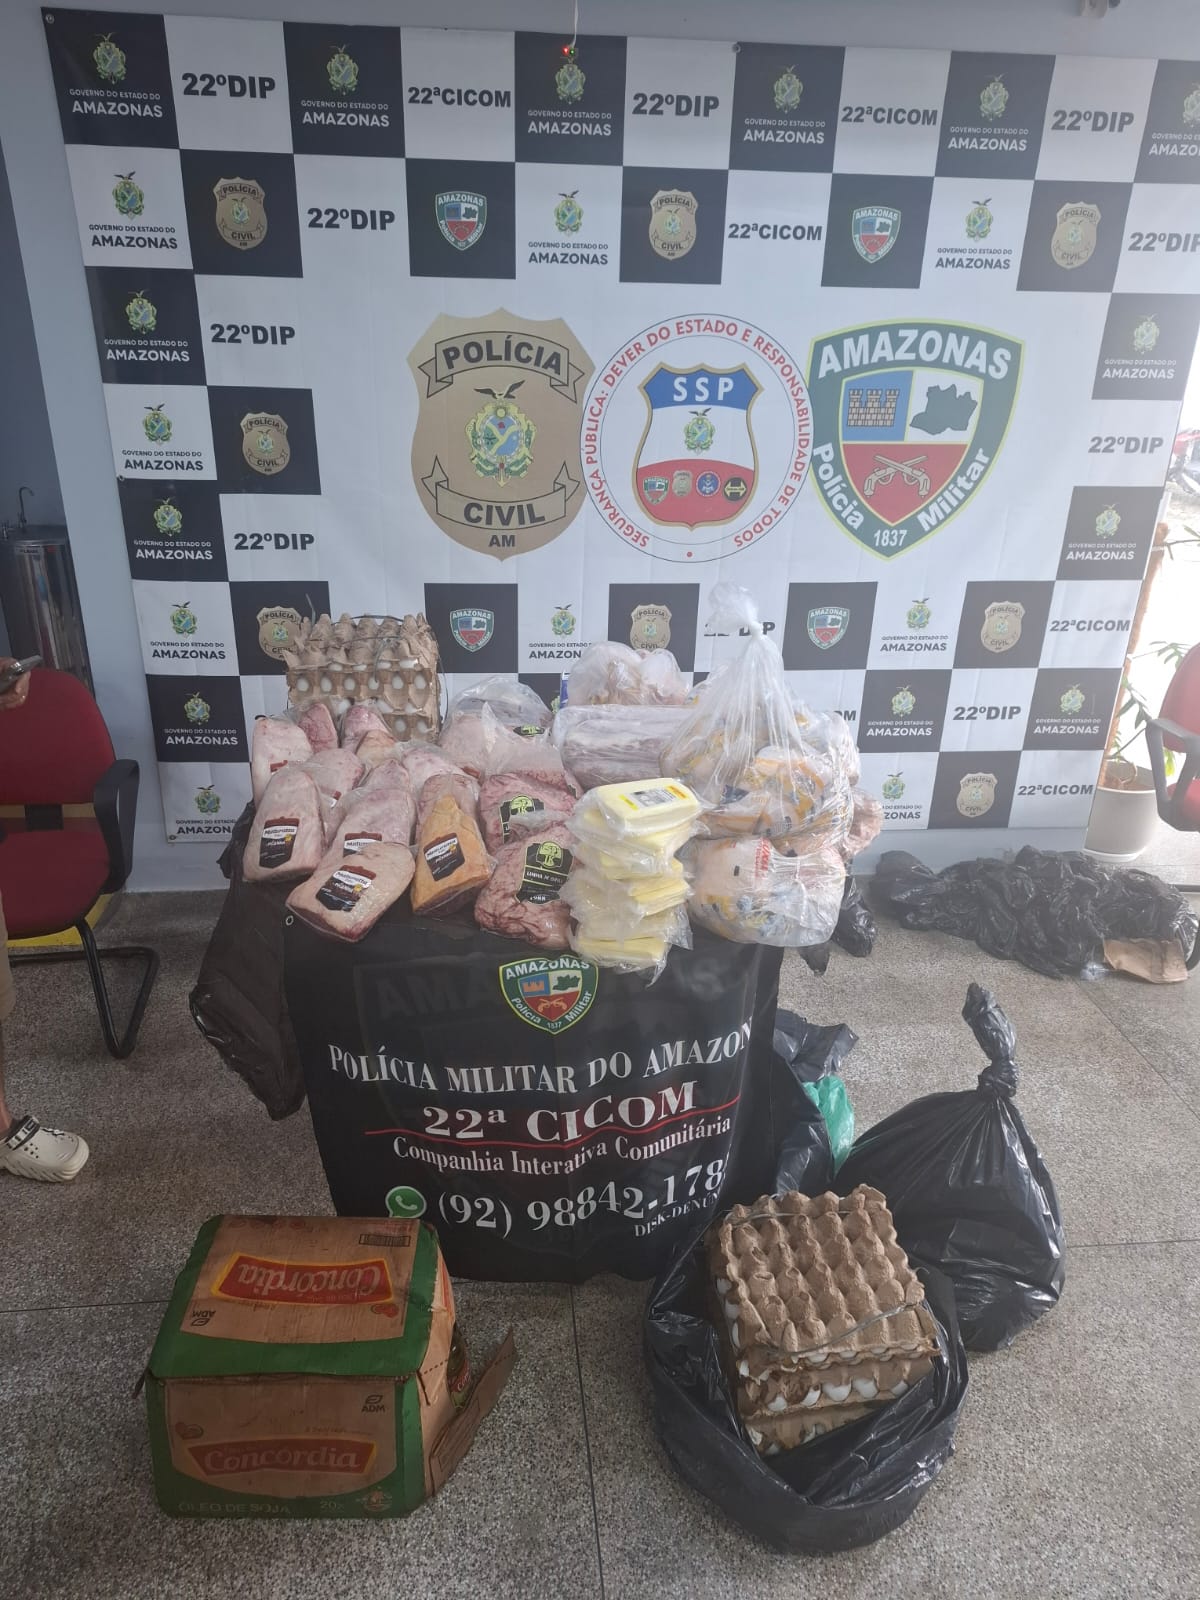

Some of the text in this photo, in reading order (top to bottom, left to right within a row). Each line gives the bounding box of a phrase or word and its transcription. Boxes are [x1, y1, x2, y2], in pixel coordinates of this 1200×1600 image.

[69, 88, 160, 100] GOVERNO DO ESTADO DO
[72, 100, 163, 118] AMAZONAS
[300, 100, 335, 108] GOVERNO
[336, 101, 348, 109] DO
[349, 101, 377, 110] ESTADO
[302, 111, 390, 128] AMAZONAS
[527, 109, 560, 118] GOVERNO
[574, 111, 600, 119] ESTADO
[527, 121, 612, 136] AMAZONAS
[744, 118, 776, 126] GOVERNO
[743, 129, 825, 144] AMAZONAS
[950, 126, 981, 134] GOVERNO
[993, 127, 1018, 135] ESTADO
[948, 137, 1027, 151] AMAZONAS
[1149, 143, 1200, 156] AMAZO
[222, 184, 257, 195] POLÍCIA
[438, 195, 484, 207] AMAZONAS
[659, 195, 691, 207] POLÍCIA
[854, 209, 898, 221] AMAZONAS
[89, 224, 123, 232] GOVERNO
[137, 225, 164, 233] ESTADO
[91, 234, 178, 250] AMAZONAS
[231, 231, 255, 241] CIVIL
[661, 242, 683, 250] CIVIL
[937, 247, 967, 255] GOVERNO
[528, 252, 608, 265] AMAZONAS
[1061, 252, 1082, 260] CIVIL
[935, 257, 1011, 270] AMAZONAS
[676, 318, 738, 336] ESTADO
[646, 326, 670, 346] DO
[741, 328, 752, 342] E
[106, 349, 190, 362] AMAZONAS
[442, 334, 561, 376] POLÍCIA
[818, 329, 1012, 380] AMAZONAS
[603, 342, 646, 387] DEVER
[1102, 368, 1176, 379] AMAZONAS
[753, 336, 810, 482] RESPONSABILIDADE
[249, 416, 280, 429] POLÍCIA
[124, 459, 204, 471] AMAZONAS
[256, 459, 278, 467] CIVIL
[813, 442, 864, 530] Polícia
[916, 447, 991, 532] Militar
[778, 488, 795, 506] DE
[463, 502, 546, 526] CIVIL
[592, 468, 650, 548] SEGURANÇA
[734, 506, 782, 547] TODOS
[134, 539, 164, 547] GOVERNO
[488, 534, 516, 547] AM
[873, 529, 907, 547] 1837
[135, 548, 214, 560] AMAZONAS
[1066, 551, 1135, 561] AMAZONAS
[880, 642, 947, 652] AMAZONAS
[152, 649, 226, 660] AMAZONAS
[528, 650, 582, 659] AMAZON
[866, 727, 932, 737] AMAZONAS
[1034, 725, 1100, 735] AMAZONAS
[166, 736, 239, 746] AMAZONAS
[884, 810, 921, 820] ZONAS
[177, 826, 232, 835] AMAZON
[505, 958, 590, 980] AMAZONAS
[511, 997, 541, 1024] Polícia
[565, 991, 592, 1022] Militar
[328, 1016, 752, 1094] POLÍCIA MILITAR DO AMAZON
[424, 1080, 697, 1142] 22ª CICOM
[393, 1116, 730, 1175] Companhia Interativa Comunitária
[438, 1192, 512, 1239] (92)
[192, 1310, 216, 1318] ADM
